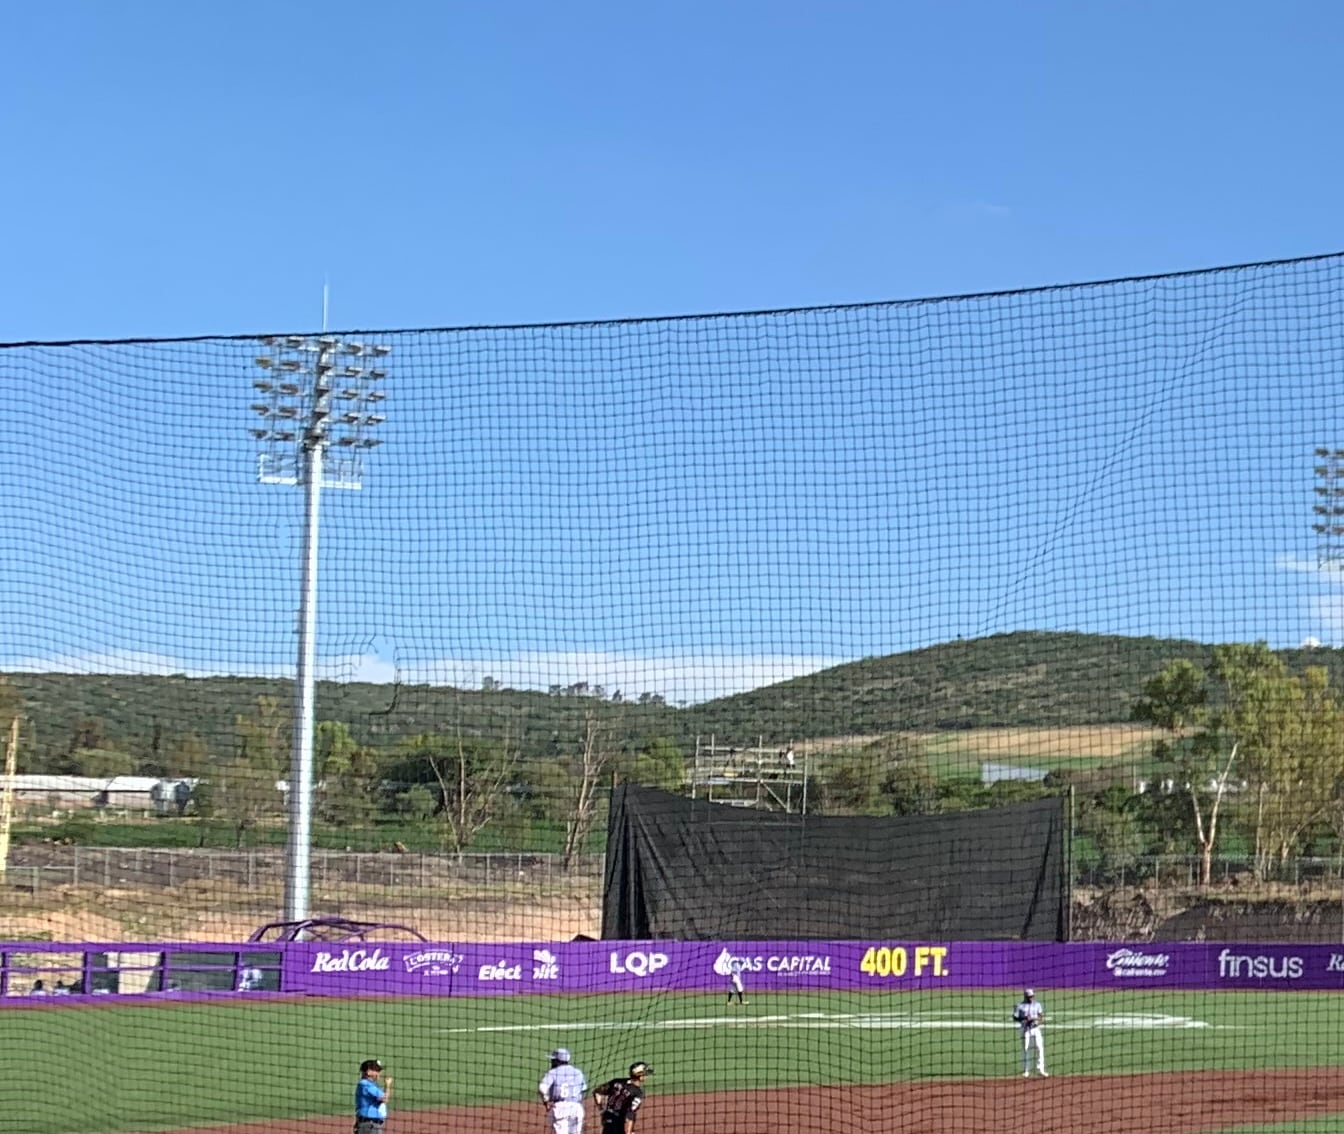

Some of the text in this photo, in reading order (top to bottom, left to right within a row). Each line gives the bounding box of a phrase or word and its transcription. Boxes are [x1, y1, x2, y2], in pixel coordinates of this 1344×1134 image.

[610, 952, 666, 976] LQP
[768, 956, 831, 972] CAPITAL
[861, 947, 949, 977] 400 FT.
[1218, 949, 1304, 978] finsus
